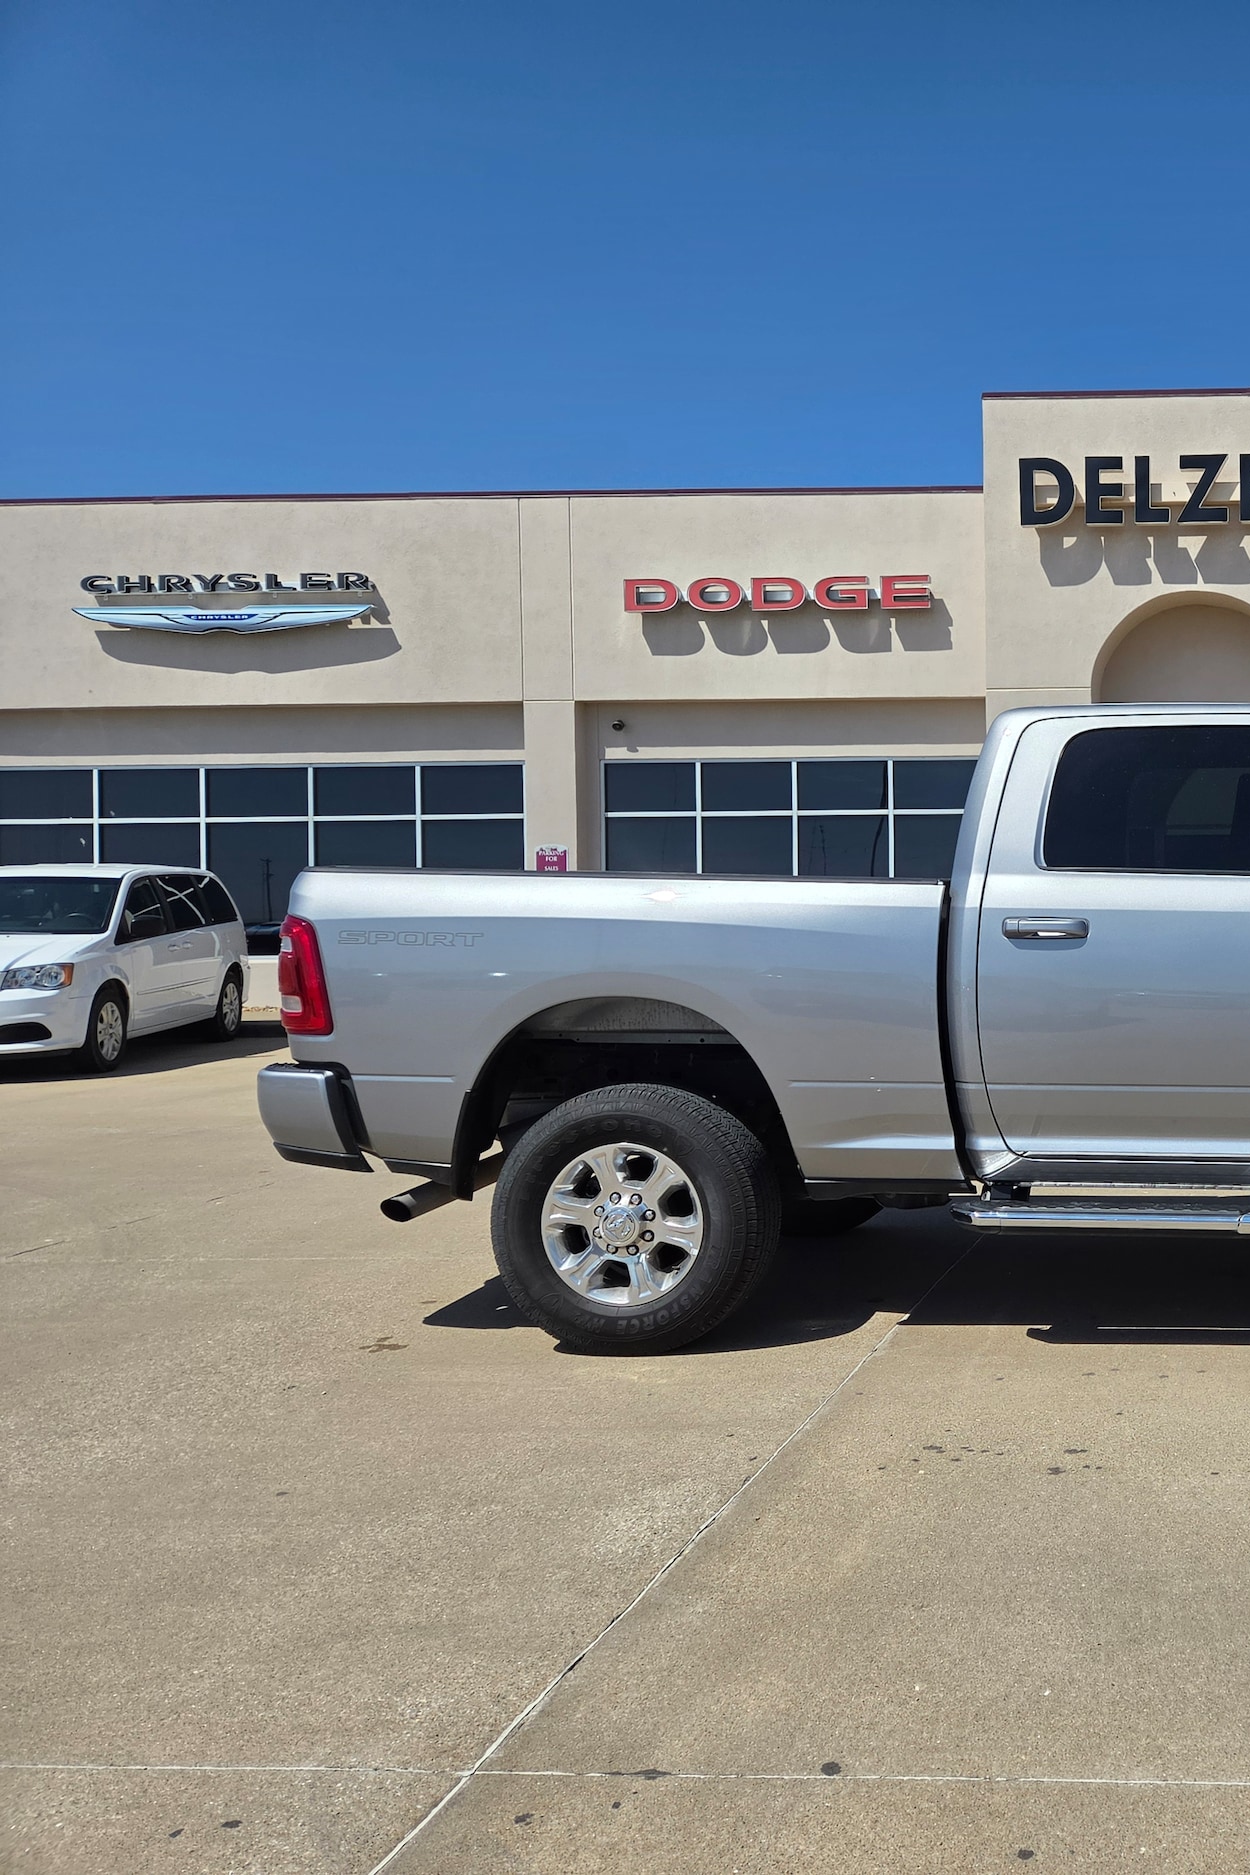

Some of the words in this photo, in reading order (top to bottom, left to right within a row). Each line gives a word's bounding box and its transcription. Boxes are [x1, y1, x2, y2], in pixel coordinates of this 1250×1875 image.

[80, 572, 373, 593] CHRYSLER
[623, 574, 931, 613] DODGE
[338, 930, 485, 947] SPORT
